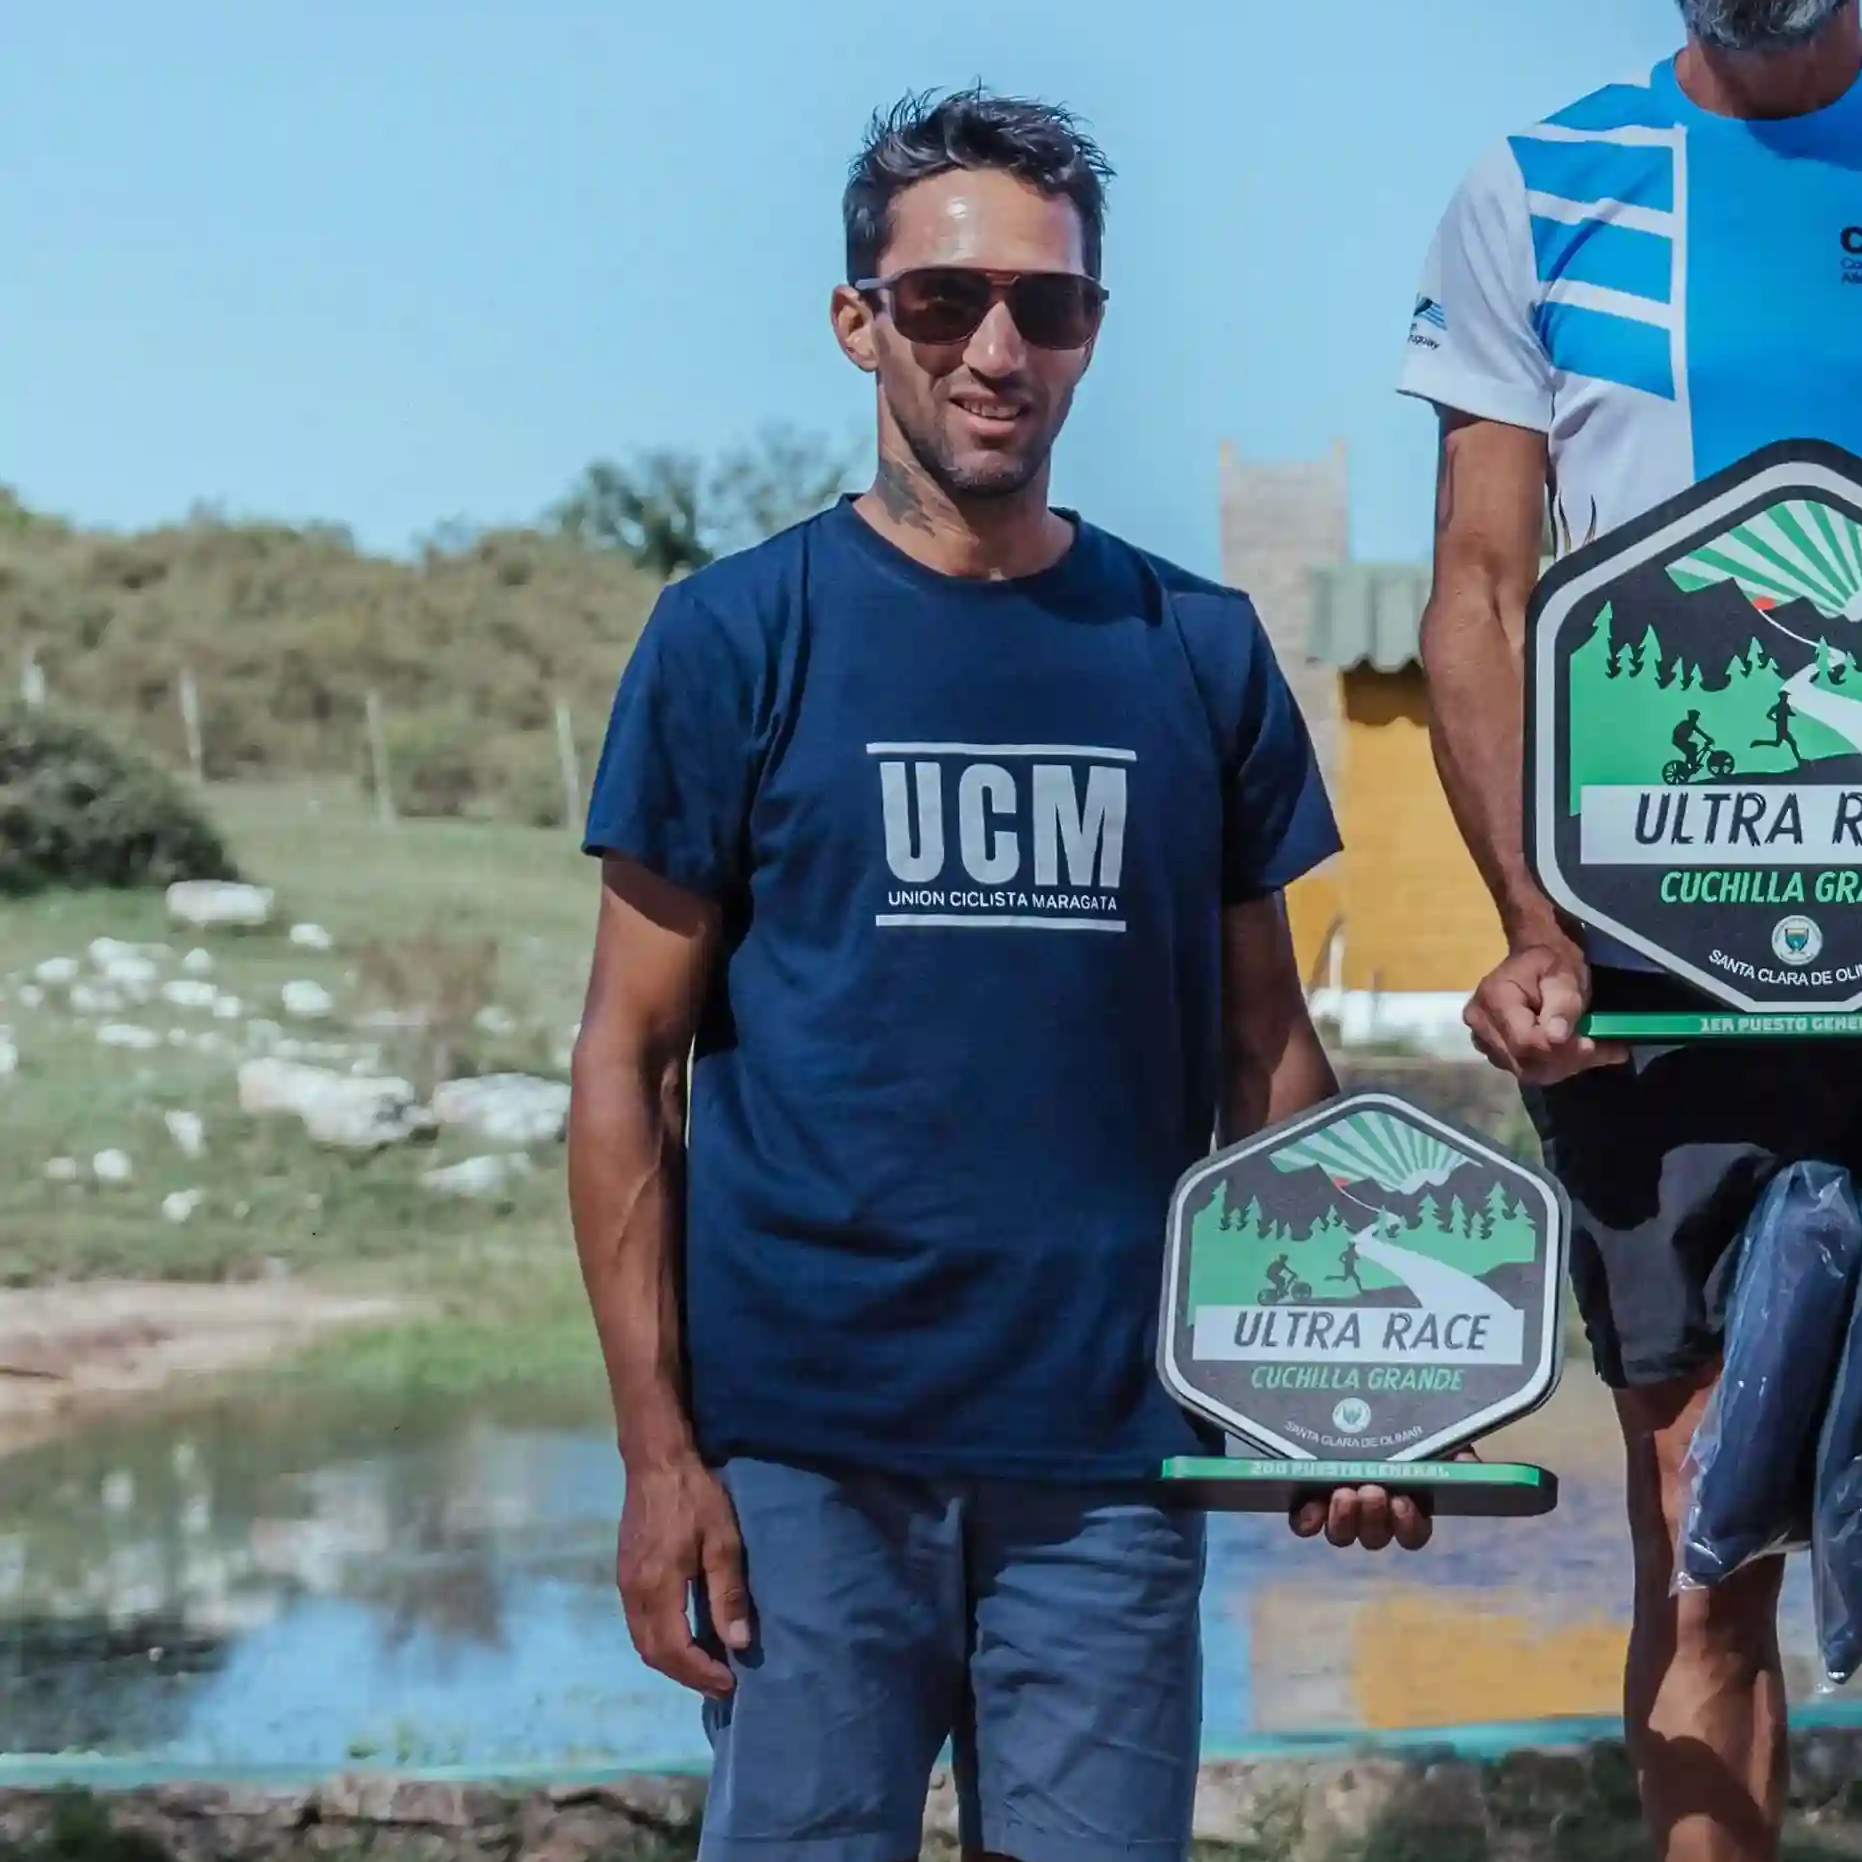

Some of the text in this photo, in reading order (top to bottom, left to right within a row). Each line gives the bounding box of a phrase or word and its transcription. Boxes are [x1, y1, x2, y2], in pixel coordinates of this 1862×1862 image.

[879, 761, 1127, 889] UCM
[1635, 791, 1801, 847] ULTRA
[888, 890, 1117, 911] UNION CICLISTA MARAGATA
[1660, 870, 1805, 904] CUCHILLA
[1708, 949, 1755, 979] SANTA
[1758, 968, 1809, 986] CLARA
[1811, 971, 1833, 986] DE
[1701, 1018, 1735, 1032] 1ER
[1738, 1017, 1808, 1032] PUESTO
[1233, 1311, 1492, 1351] ULTRA RACE
[1251, 1365, 1465, 1390] CUCHILLA GRANDE
